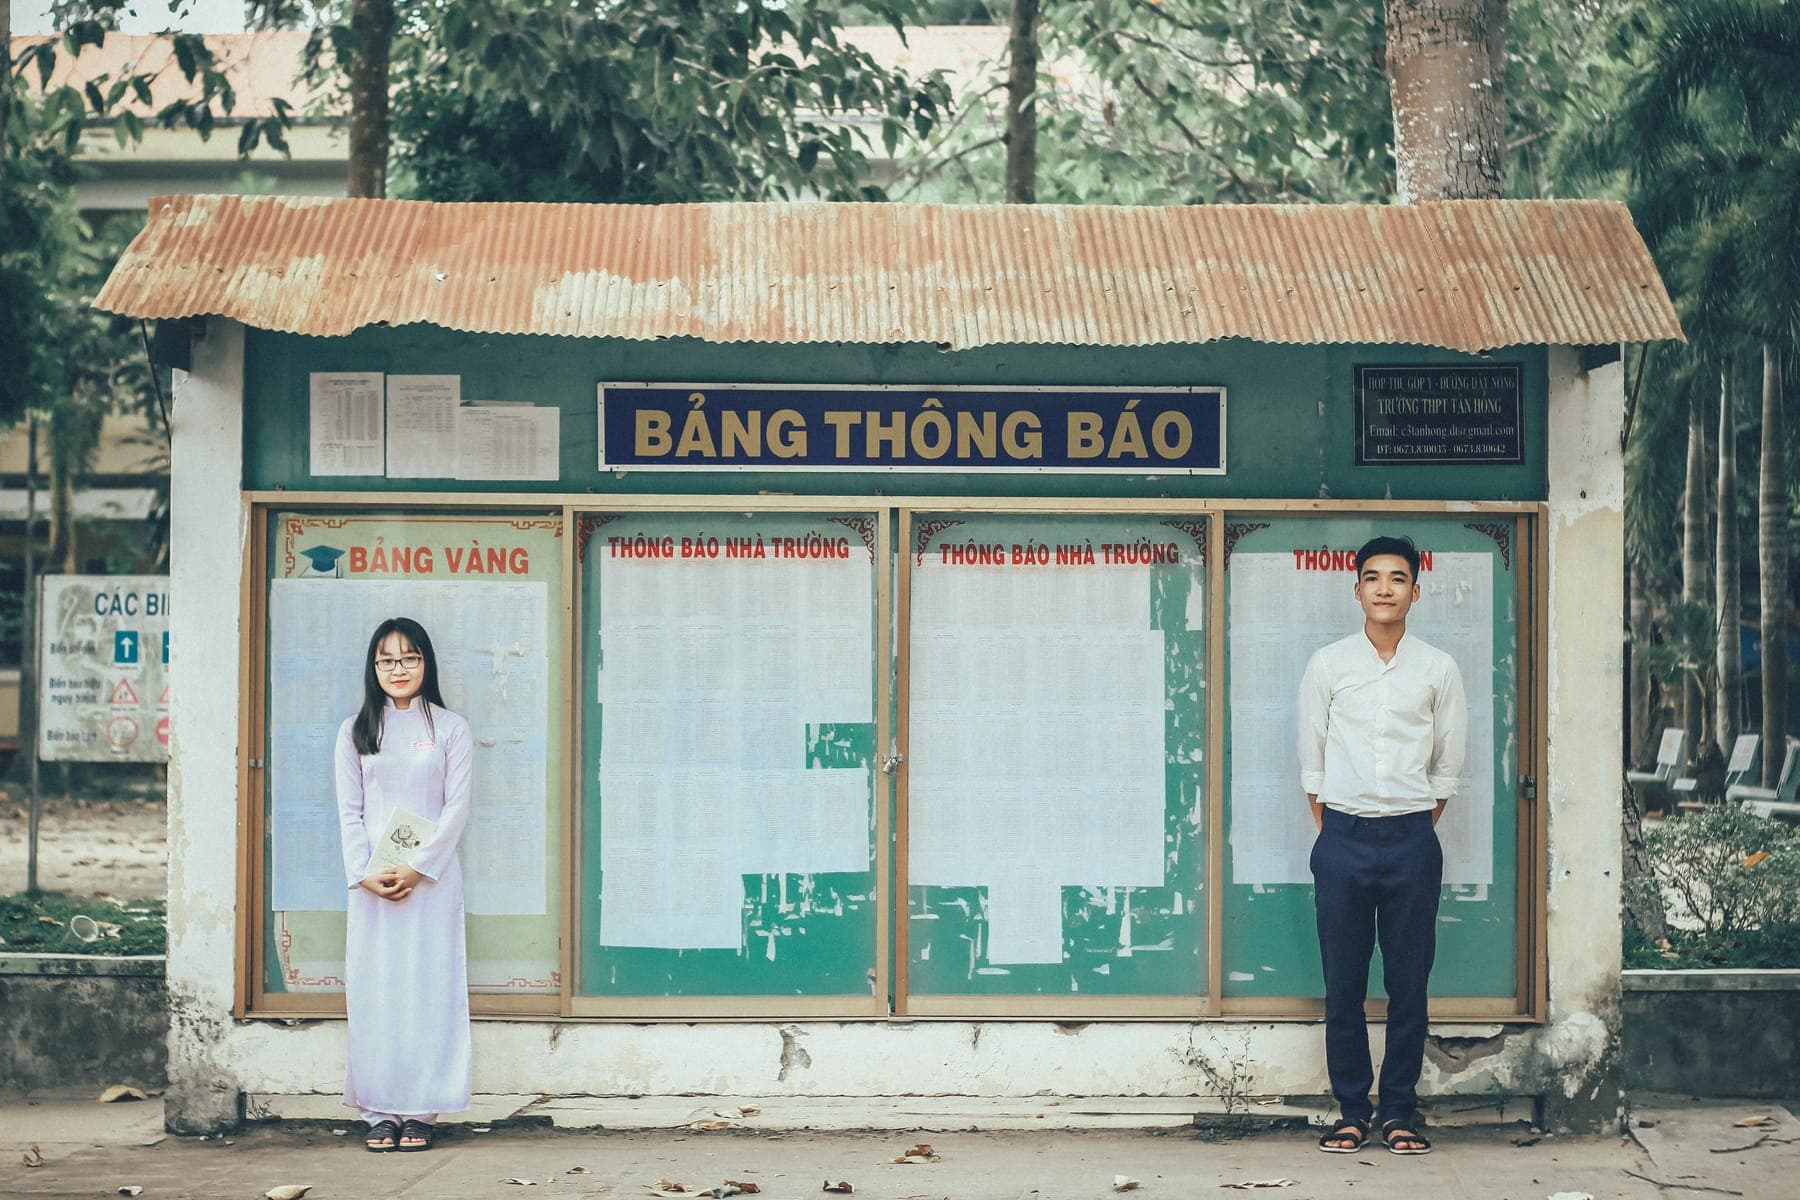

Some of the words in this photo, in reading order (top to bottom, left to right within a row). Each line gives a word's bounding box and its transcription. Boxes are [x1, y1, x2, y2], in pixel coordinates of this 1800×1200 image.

[1421, 398, 1448, 414] THPT
[634, 392, 808, 458] BẢNG
[824, 397, 1043, 460] THÔNG
[1067, 399, 1193, 460] BÁO
[349, 536, 433, 574] BẢNG
[444, 540, 529, 574] VÀNG
[608, 532, 674, 558] THÔNG
[680, 532, 719, 559] BÁO
[726, 533, 765, 559] NHÀ
[771, 531, 849, 559] TRƯỜNG
[939, 538, 1005, 565] THÔNG
[1011, 538, 1050, 566] BÁO
[1056, 538, 1095, 566] NHÀ
[1101, 537, 1179, 565] TRƯỜNG
[1293, 545, 1358, 571] THÔNG
[95, 586, 138, 616] CÁC
[146, 593, 170, 616] BI
